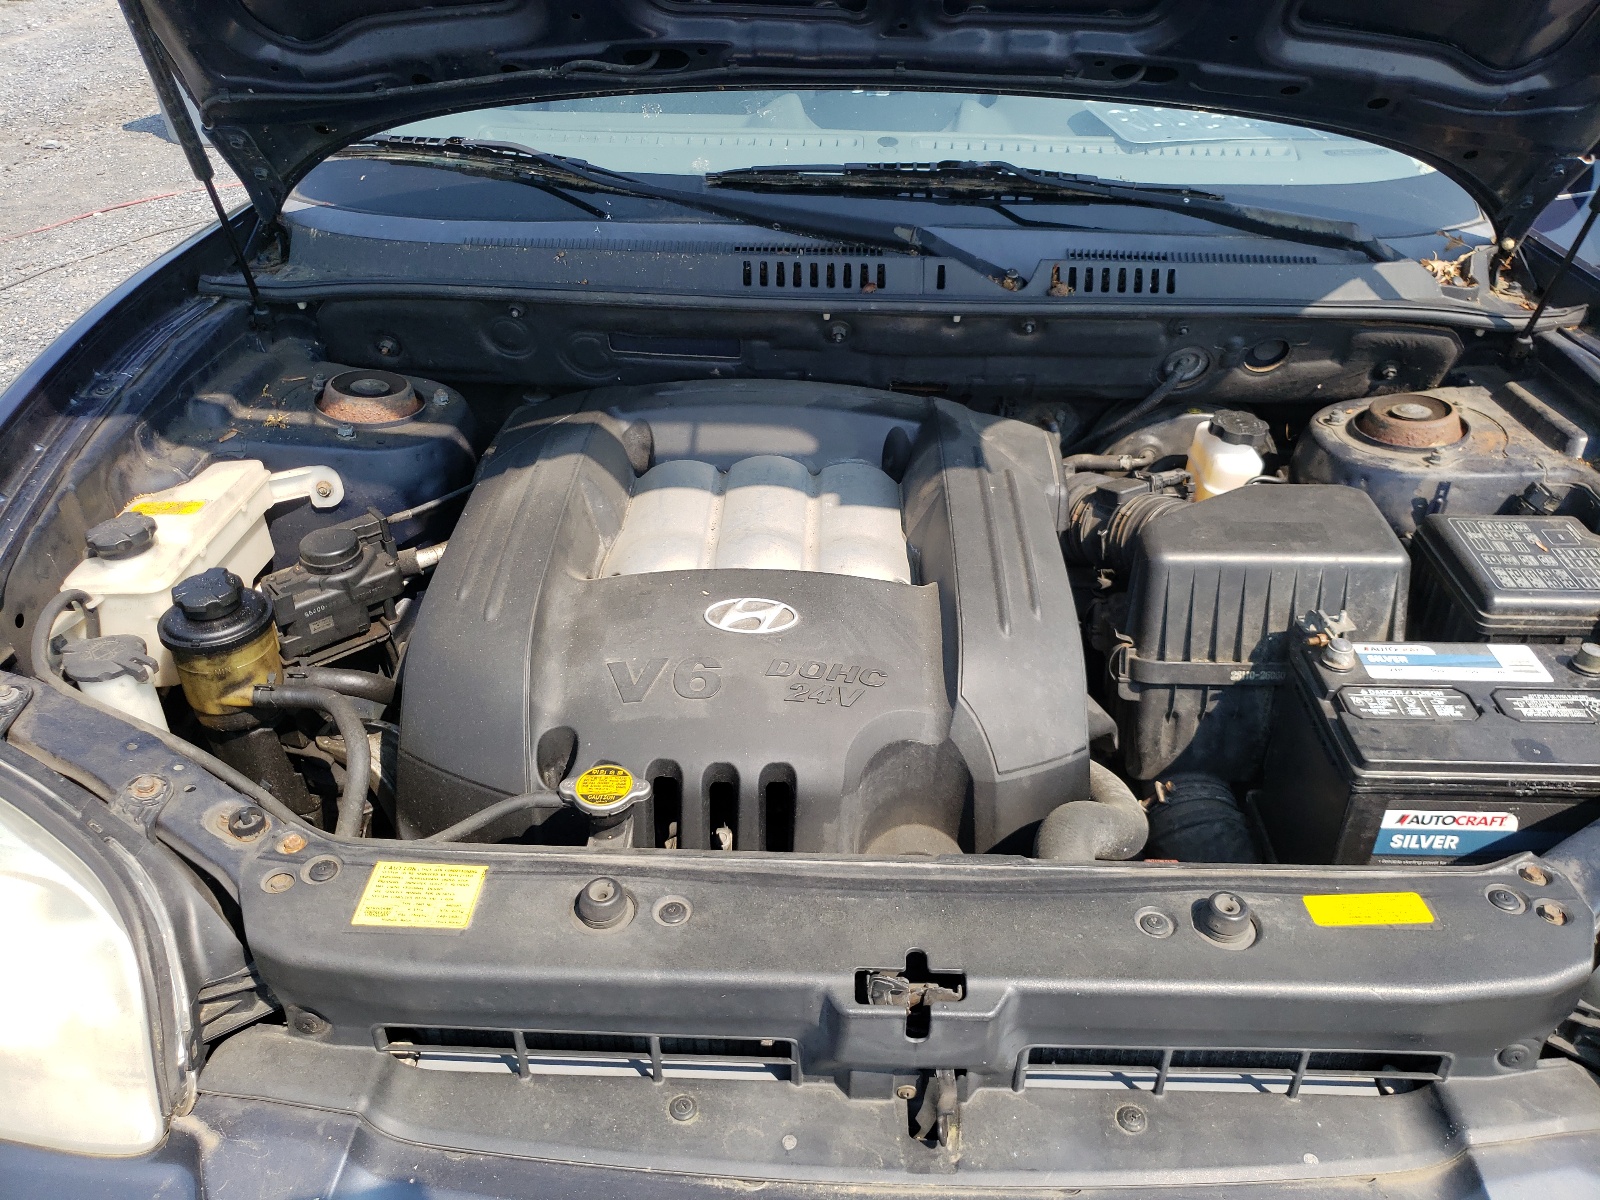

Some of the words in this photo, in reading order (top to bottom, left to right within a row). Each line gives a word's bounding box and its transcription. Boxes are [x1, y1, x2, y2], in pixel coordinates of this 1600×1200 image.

[604, 657, 722, 704] V6
[765, 659, 888, 687] DOHC
[783, 682, 866, 707] 24V
[1407, 814, 1507, 827] AUTOCRAFT
[1390, 834, 1459, 849] SILVER
